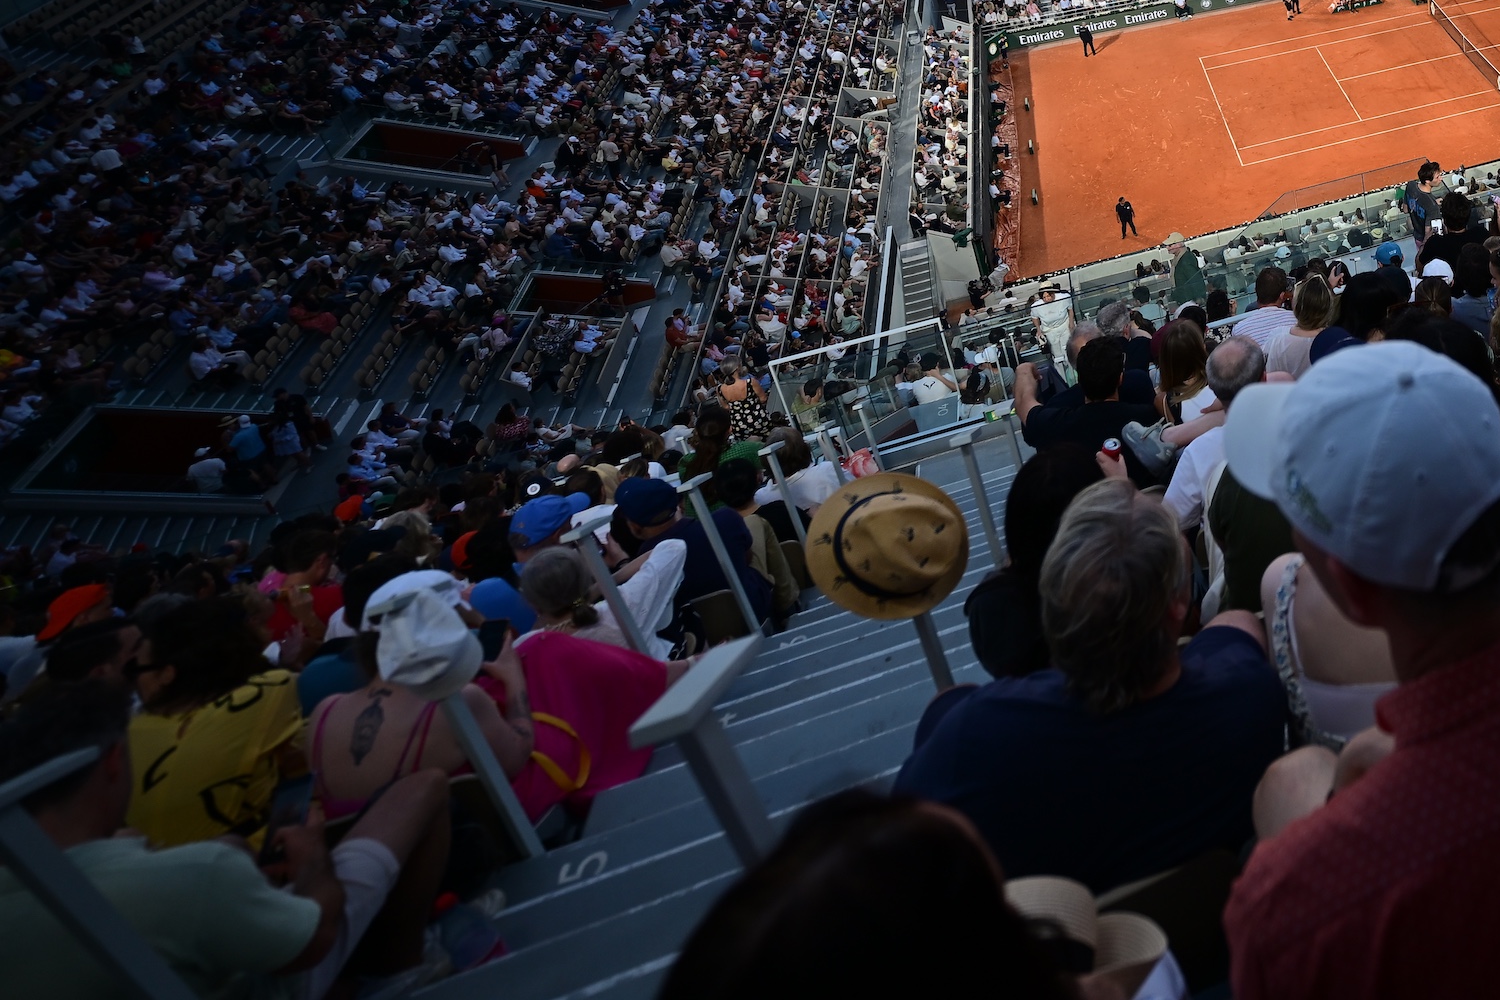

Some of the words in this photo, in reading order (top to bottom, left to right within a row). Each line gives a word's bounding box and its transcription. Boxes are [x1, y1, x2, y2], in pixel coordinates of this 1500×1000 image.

[1124, 8, 1167, 25] Emirates
[1018, 28, 1064, 46] Emirates
[938, 403, 949, 416] 04
[557, 850, 608, 886] 5
